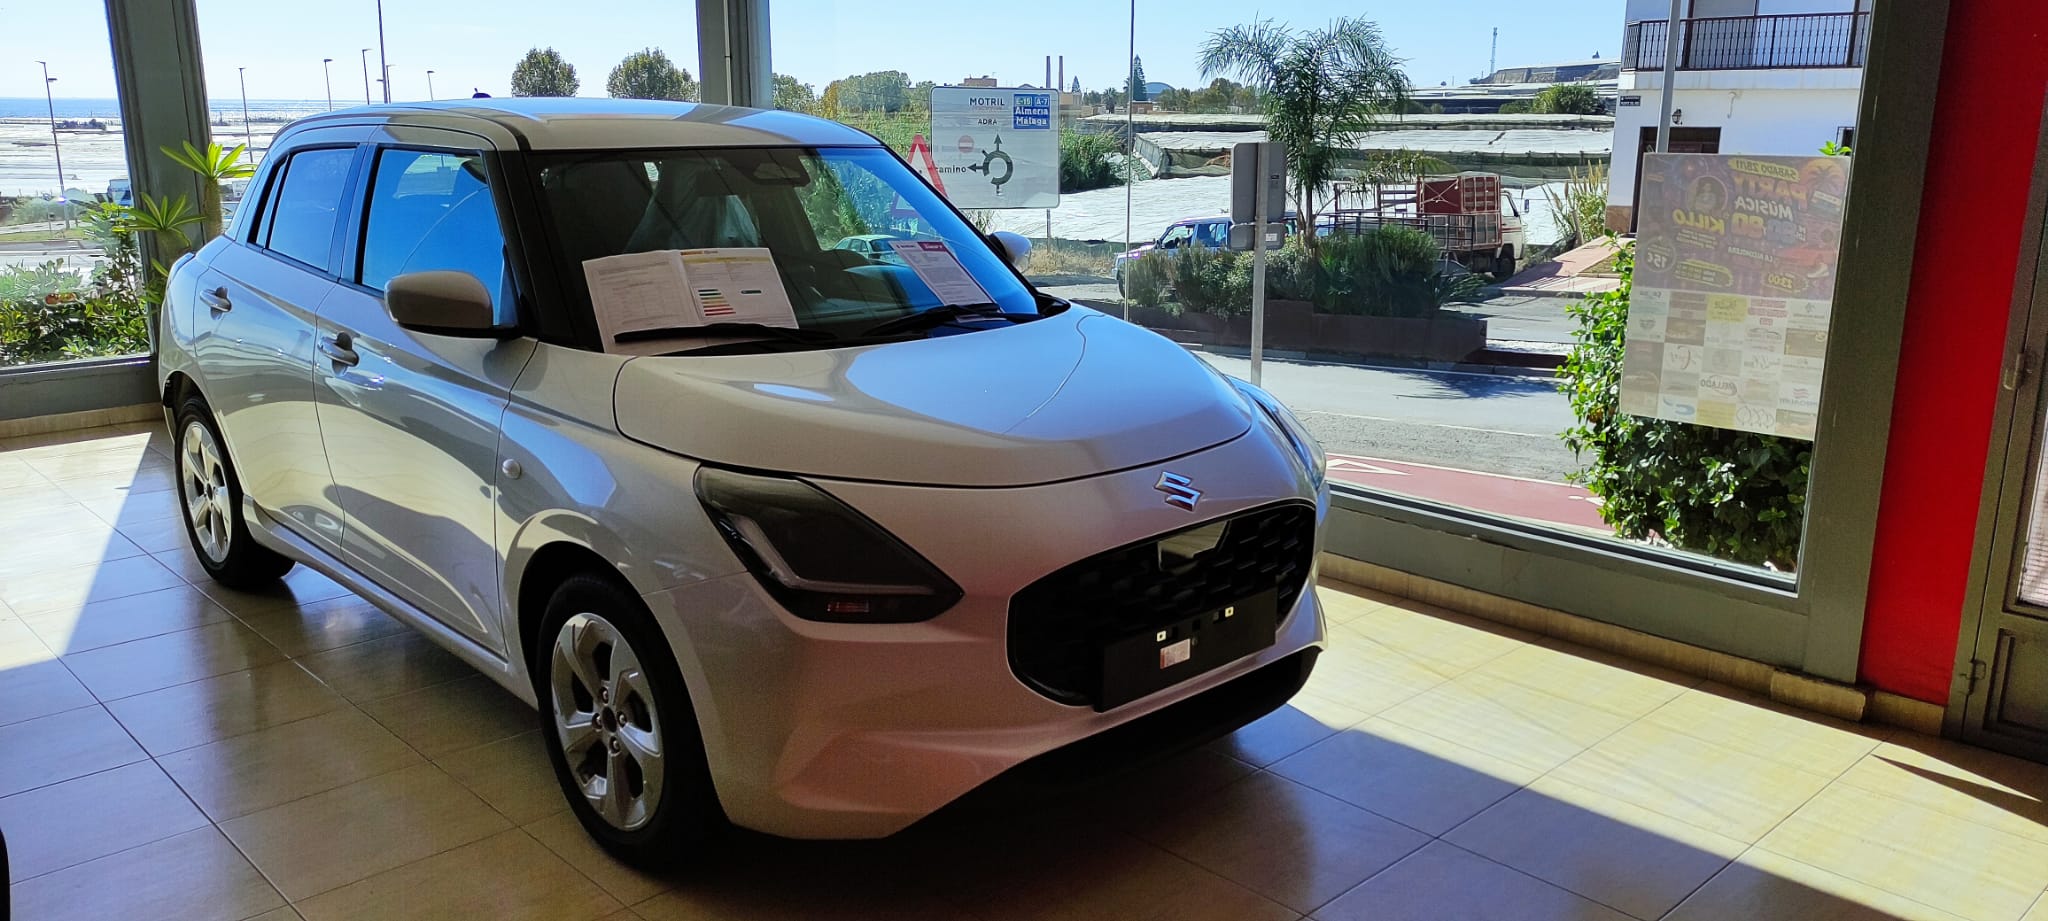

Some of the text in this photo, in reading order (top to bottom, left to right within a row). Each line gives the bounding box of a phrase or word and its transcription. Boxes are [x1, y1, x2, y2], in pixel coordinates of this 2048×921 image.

[969, 97, 1005, 106] MOTRIL
[1036, 97, 1048, 105] A-7
[1015, 116, 1047, 126] Málaga
